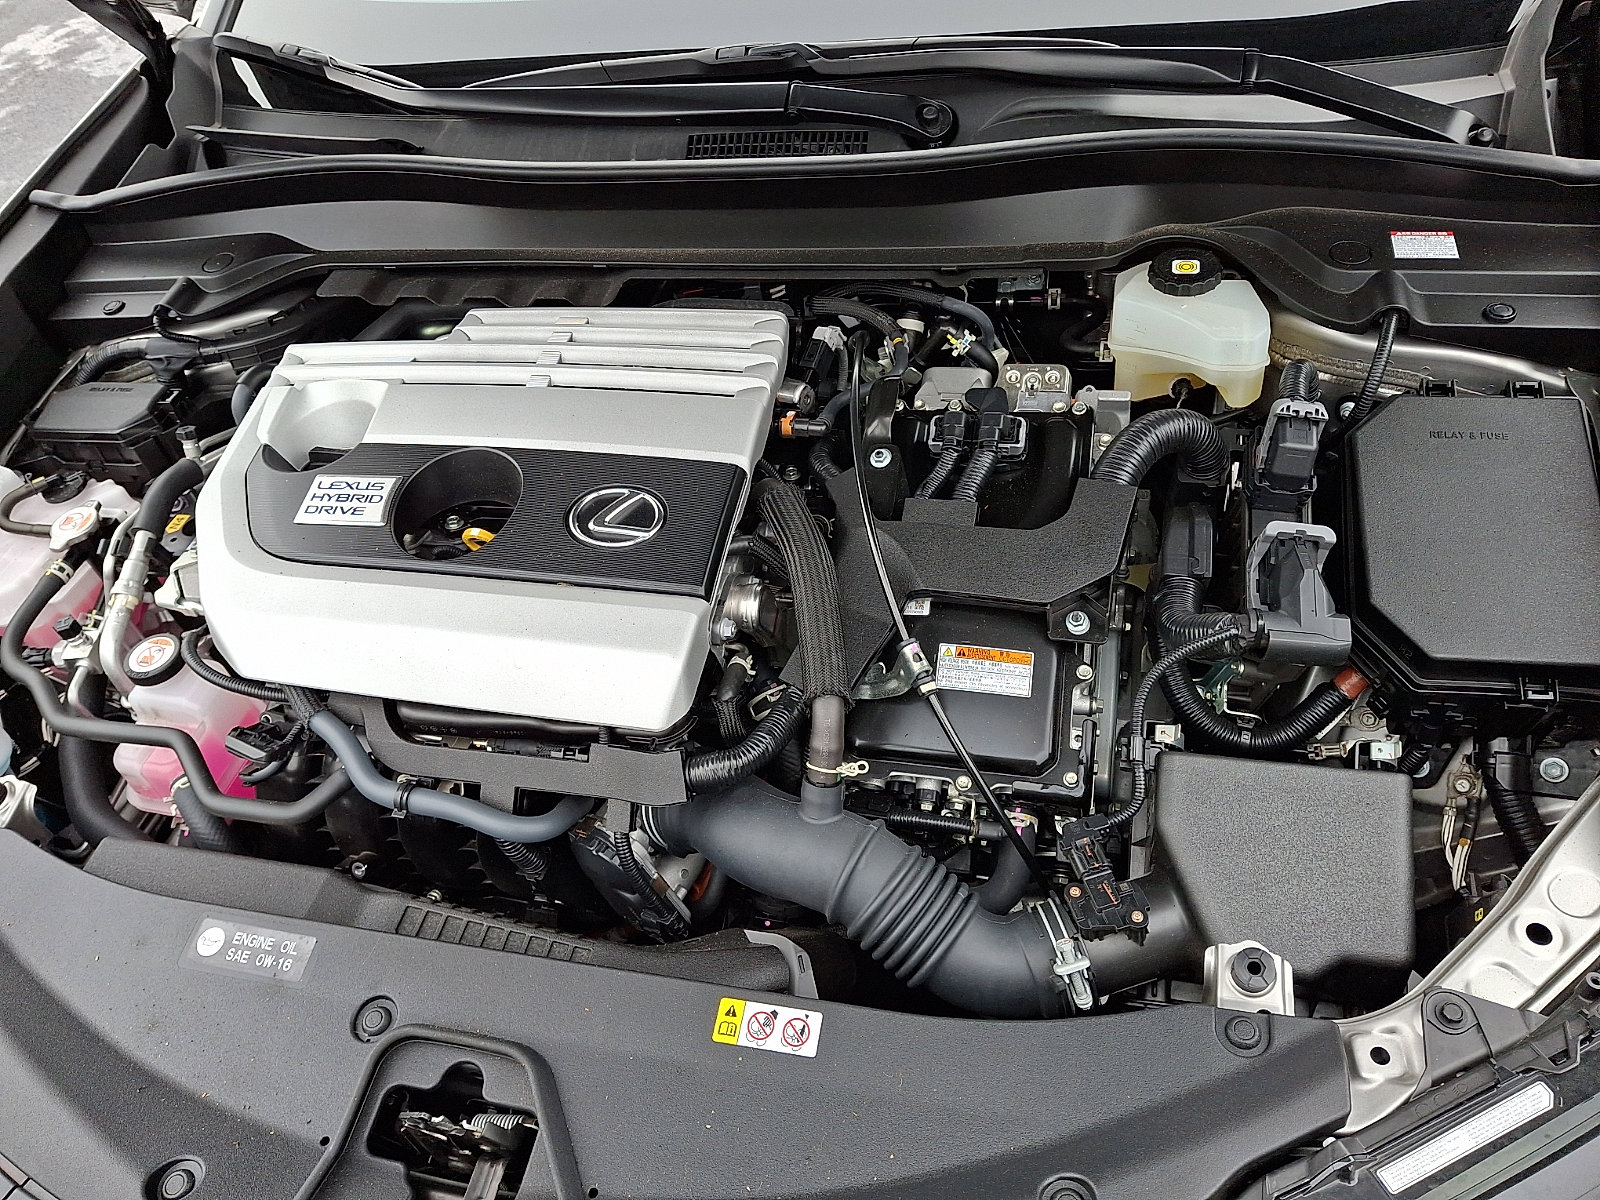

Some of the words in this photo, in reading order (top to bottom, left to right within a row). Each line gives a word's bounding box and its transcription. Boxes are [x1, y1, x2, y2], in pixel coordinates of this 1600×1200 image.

[1428, 430, 1465, 440] RELAY
[1468, 431, 1477, 440] &
[1479, 431, 1510, 441] FUSE
[317, 480, 386, 491] LEXUS
[310, 492, 384, 504] HYBRID
[303, 504, 367, 516] DRIVE
[231, 931, 276, 951] ENGINE
[280, 940, 298, 956] OIL
[225, 947, 252, 964] SAE
